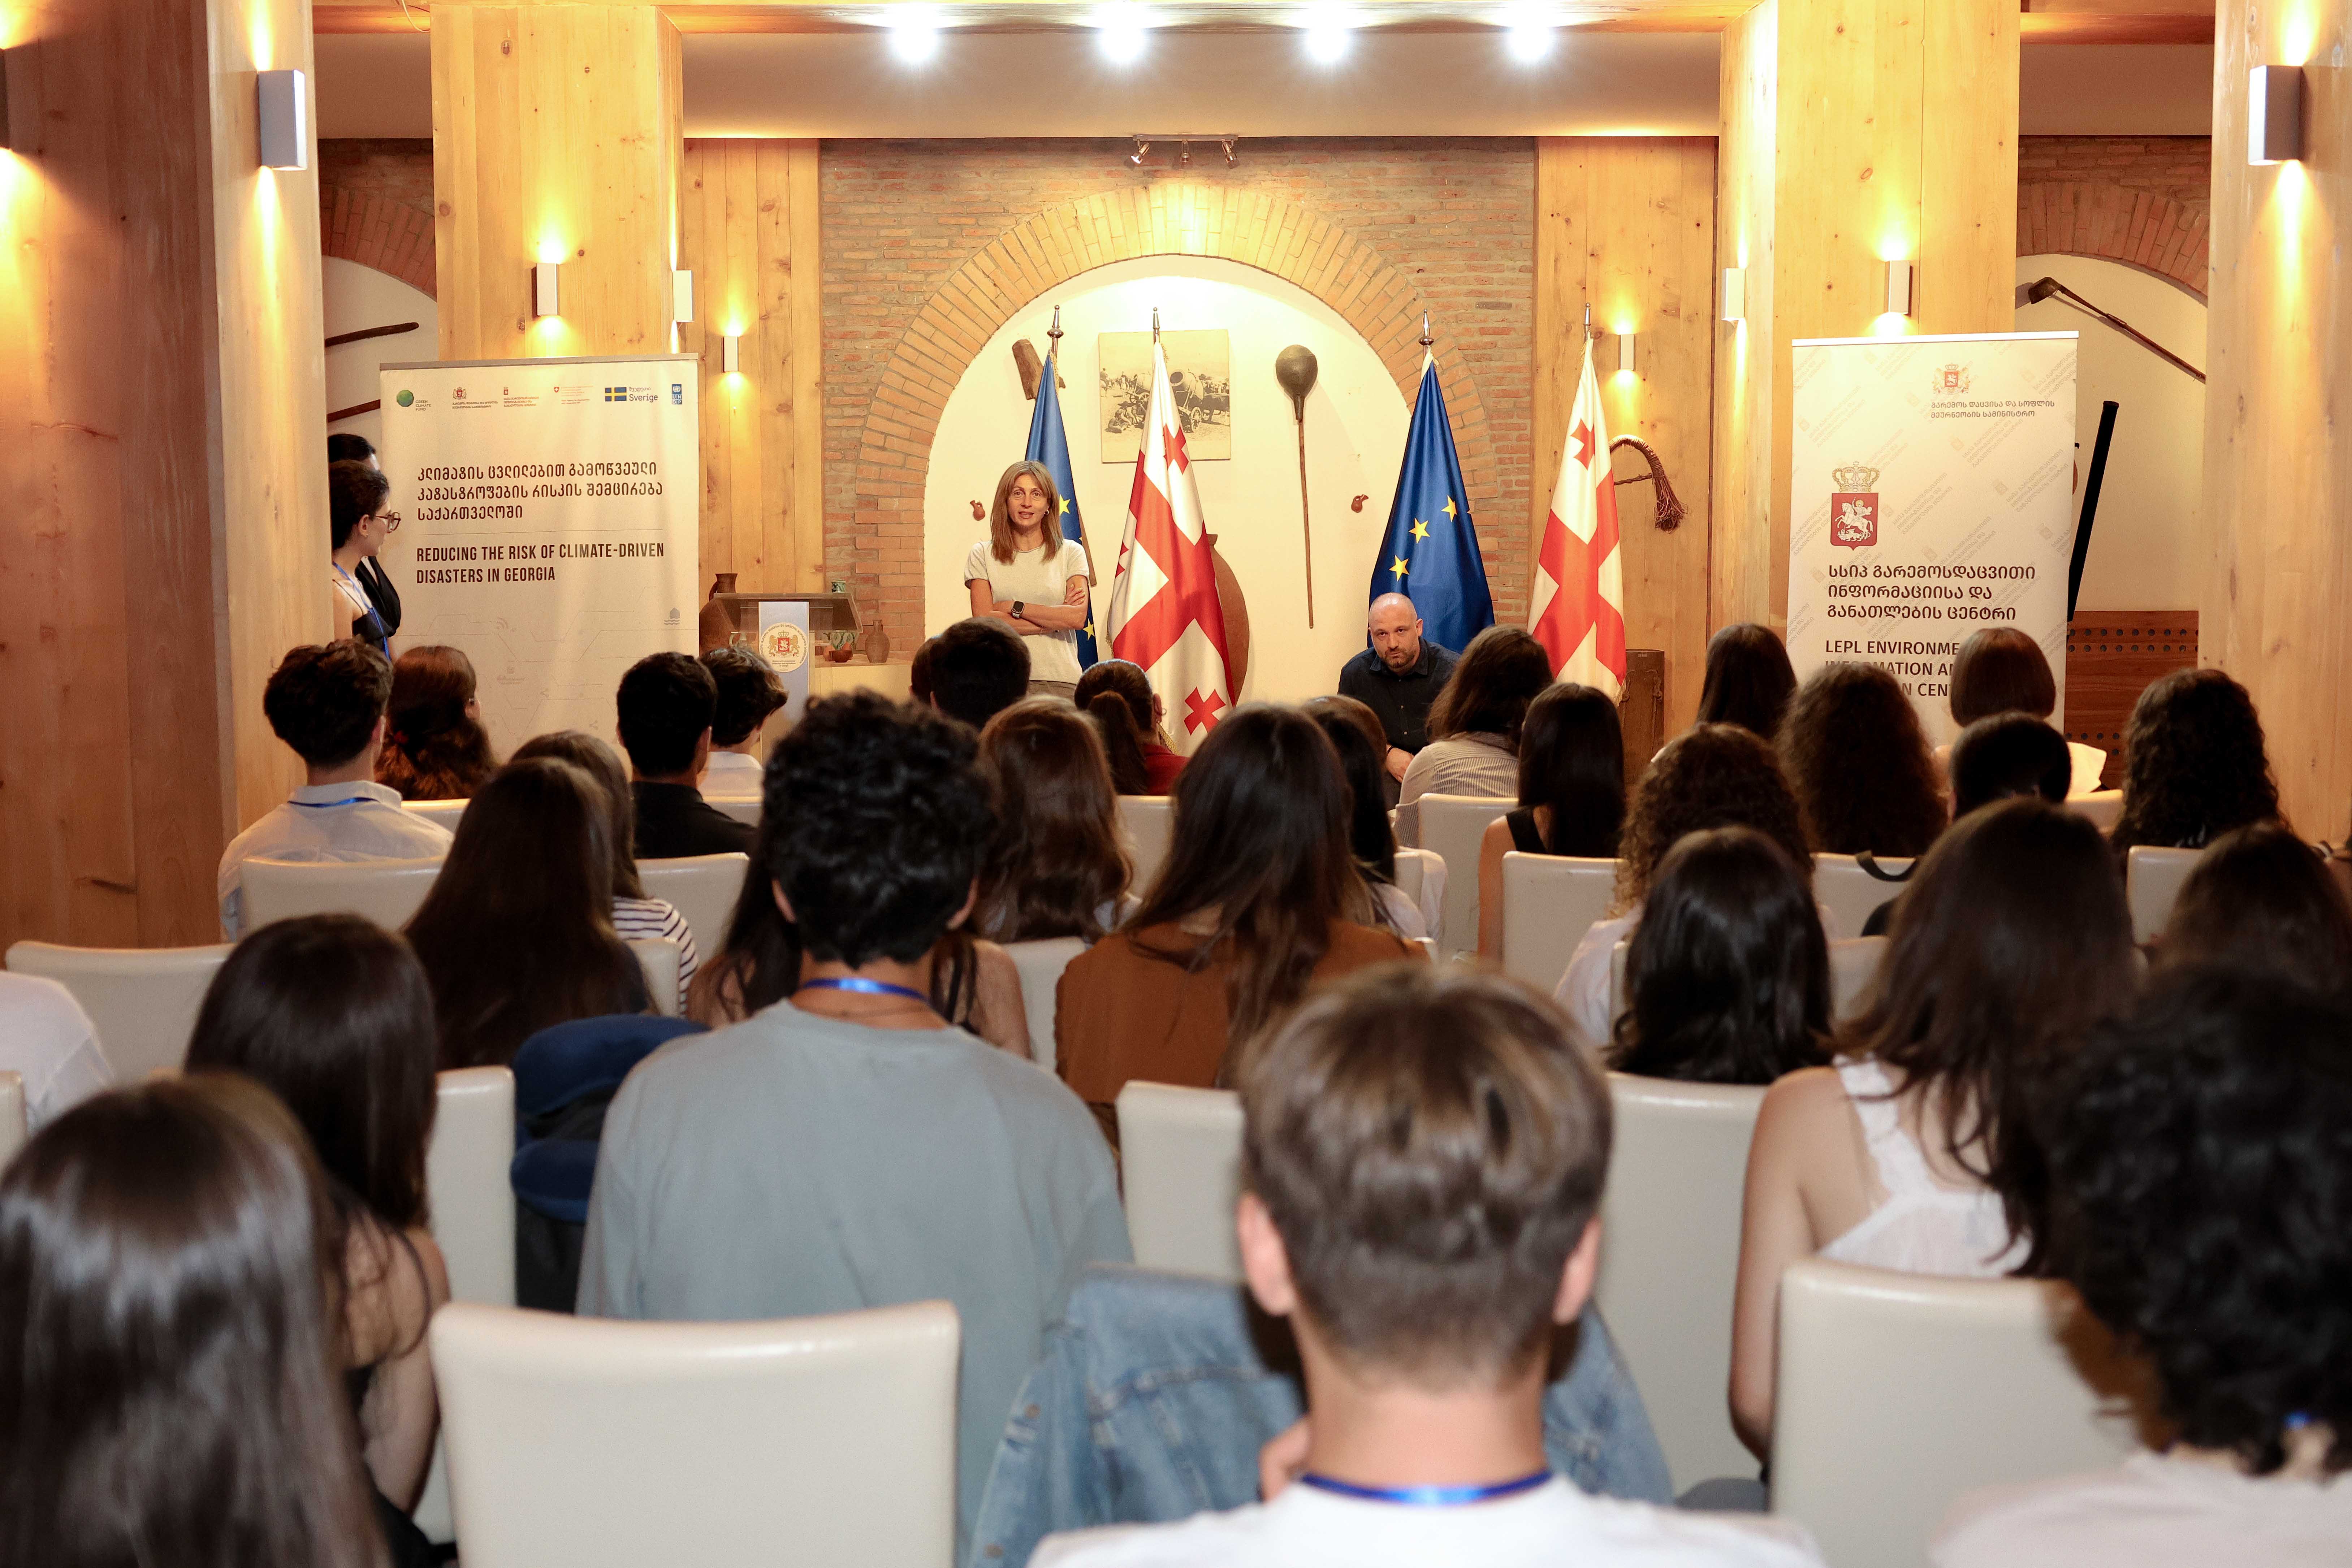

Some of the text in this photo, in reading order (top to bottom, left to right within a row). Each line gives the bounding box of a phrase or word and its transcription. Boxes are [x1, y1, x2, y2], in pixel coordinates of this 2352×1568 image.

[629, 394, 658, 402] Sverige
[418, 462, 656, 481] კლიმატის ცვლილებით გამოწვეული
[418, 482, 662, 501] კატასტროფების რისკის შემცირება
[418, 505, 523, 520] საქართველოში
[417, 543, 664, 562] REDUCING THE RISK OF CLIMATE-DRIVEN
[417, 567, 555, 584] DISASTERS IN GEORGIA
[1829, 565, 2035, 579] სსიპ გარემოსდაცვითი
[1828, 585, 1963, 599] ინფორმაციისა
[1969, 586, 1992, 599] და
[1827, 605, 2016, 620] განათლების ცენტრი
[1825, 640, 1960, 655] LEPL ENVIRONME
[1825, 660, 1932, 675] MATION
[1918, 683, 1951, 696] CEN
